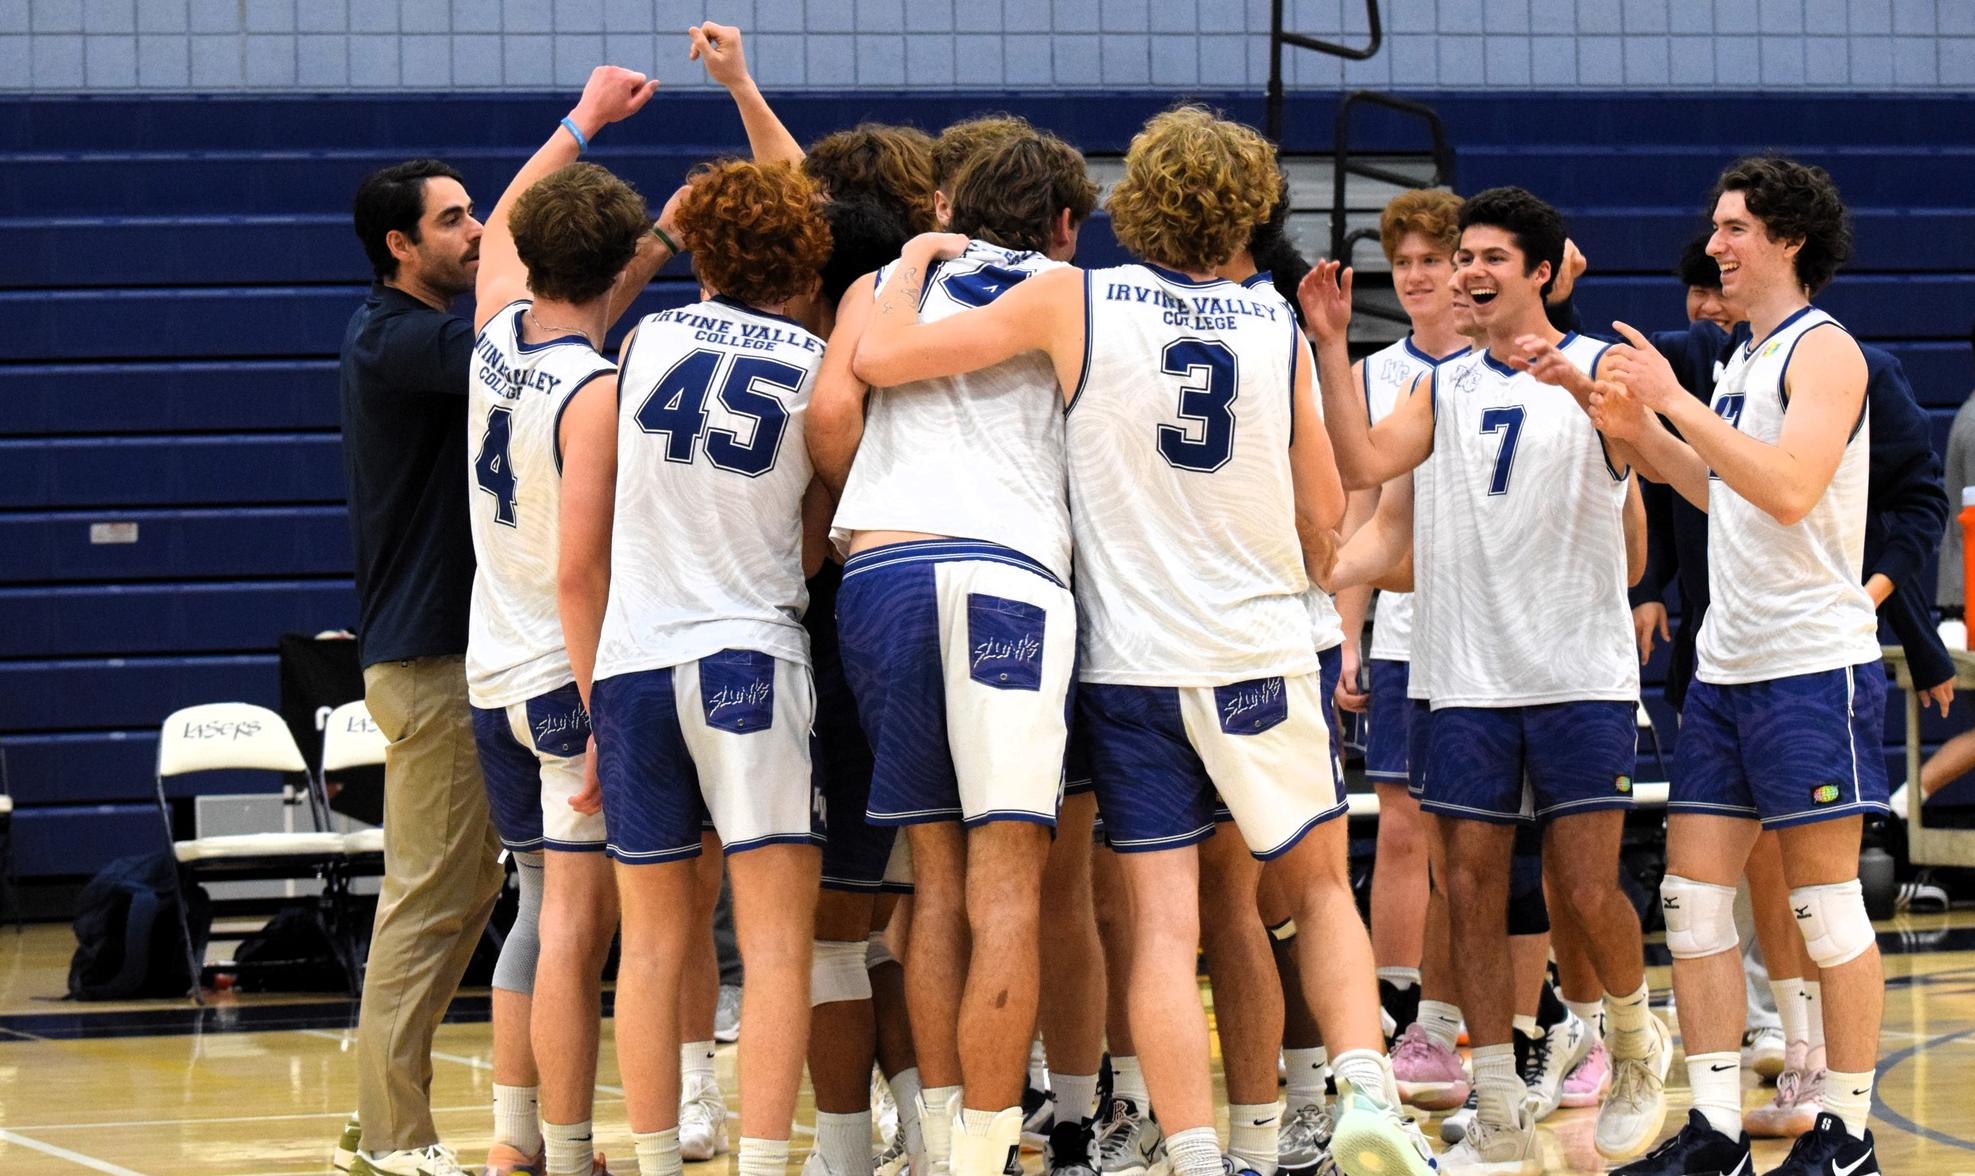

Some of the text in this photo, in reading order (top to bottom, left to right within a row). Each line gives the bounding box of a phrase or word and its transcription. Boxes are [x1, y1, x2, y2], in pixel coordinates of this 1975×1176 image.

[694, 330, 778, 352] COLLEGE
[1106, 283, 1277, 322] IRVINE VALLEY
[1162, 311, 1238, 331] COLLEGE
[634, 347, 808, 478] 45
[1156, 336, 1239, 474] 3
[1479, 404, 1528, 496] 7
[474, 404, 518, 528] 4
